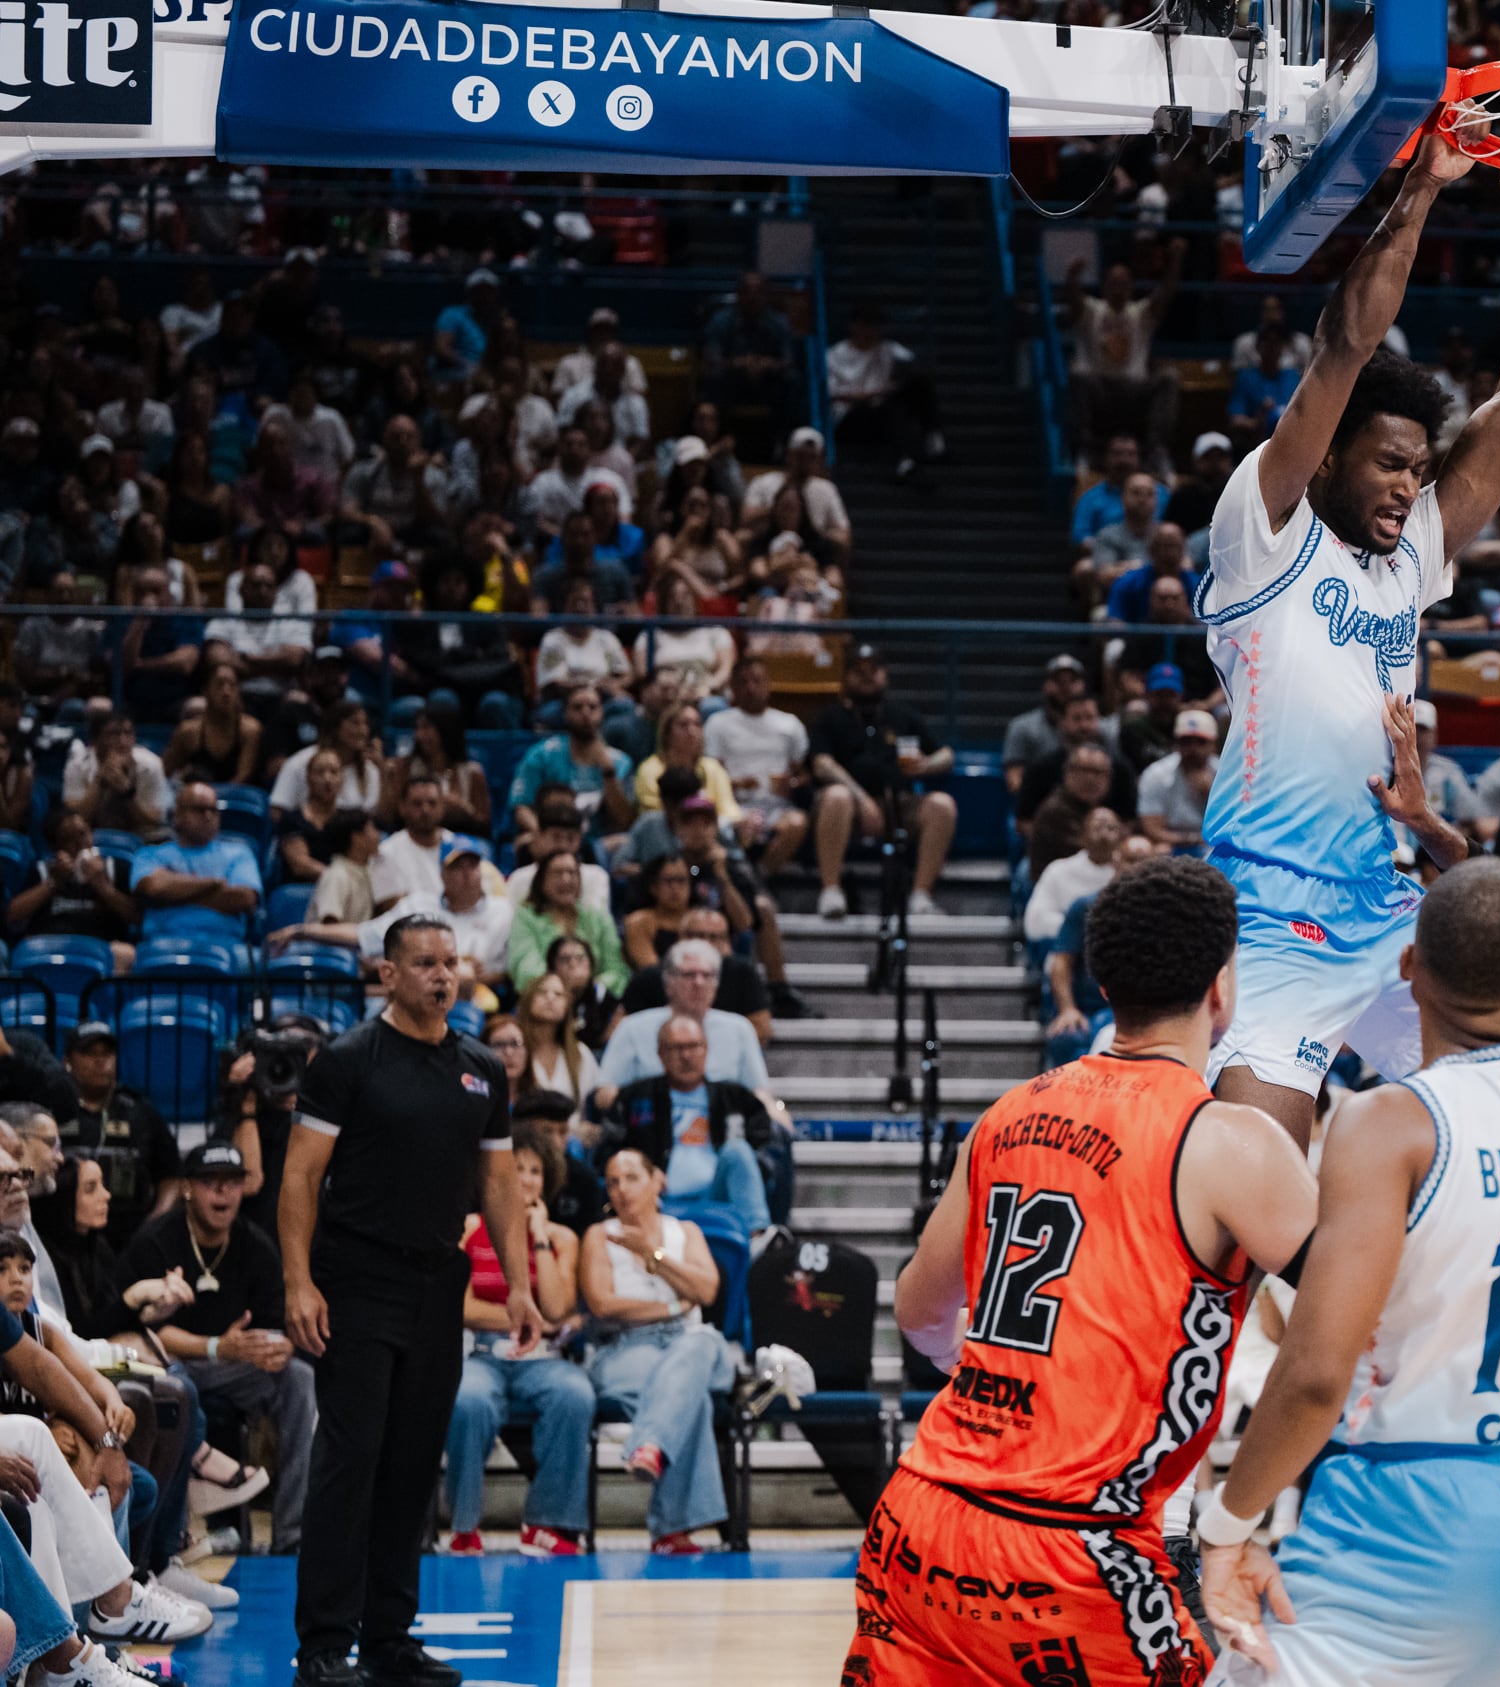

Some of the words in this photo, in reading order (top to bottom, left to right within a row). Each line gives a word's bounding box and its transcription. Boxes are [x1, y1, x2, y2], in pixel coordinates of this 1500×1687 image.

[0, 2, 138, 111] ite
[249, 8, 864, 83] CIUDADDEBAYAMON
[993, 1112, 1124, 1180] PACHECO-ORTIZ
[965, 1182, 1086, 1357] 12
[896, 1536, 1056, 1601] brava
